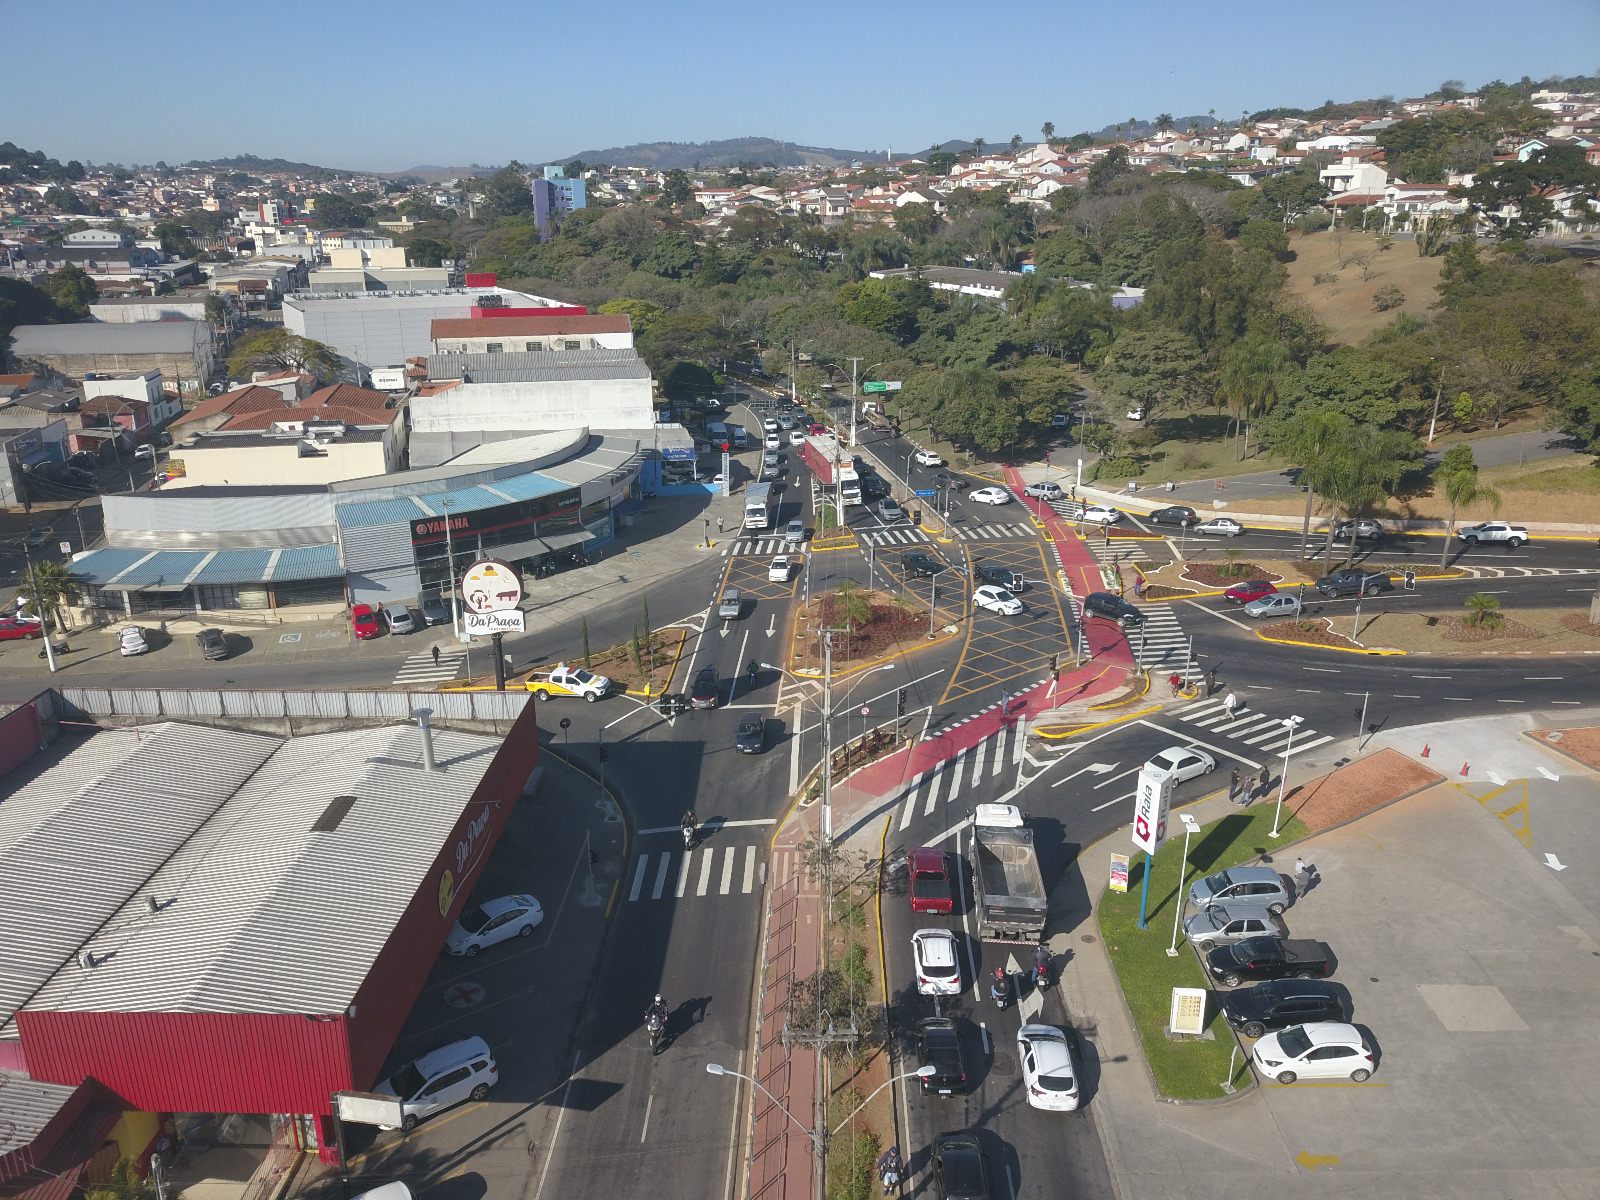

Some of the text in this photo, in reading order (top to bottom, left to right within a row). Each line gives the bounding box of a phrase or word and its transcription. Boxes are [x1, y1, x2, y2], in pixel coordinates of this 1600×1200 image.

[427, 517, 469, 533] YAMAHA
[468, 614, 521, 628] Da Praça
[1141, 784, 1152, 820] Raia
